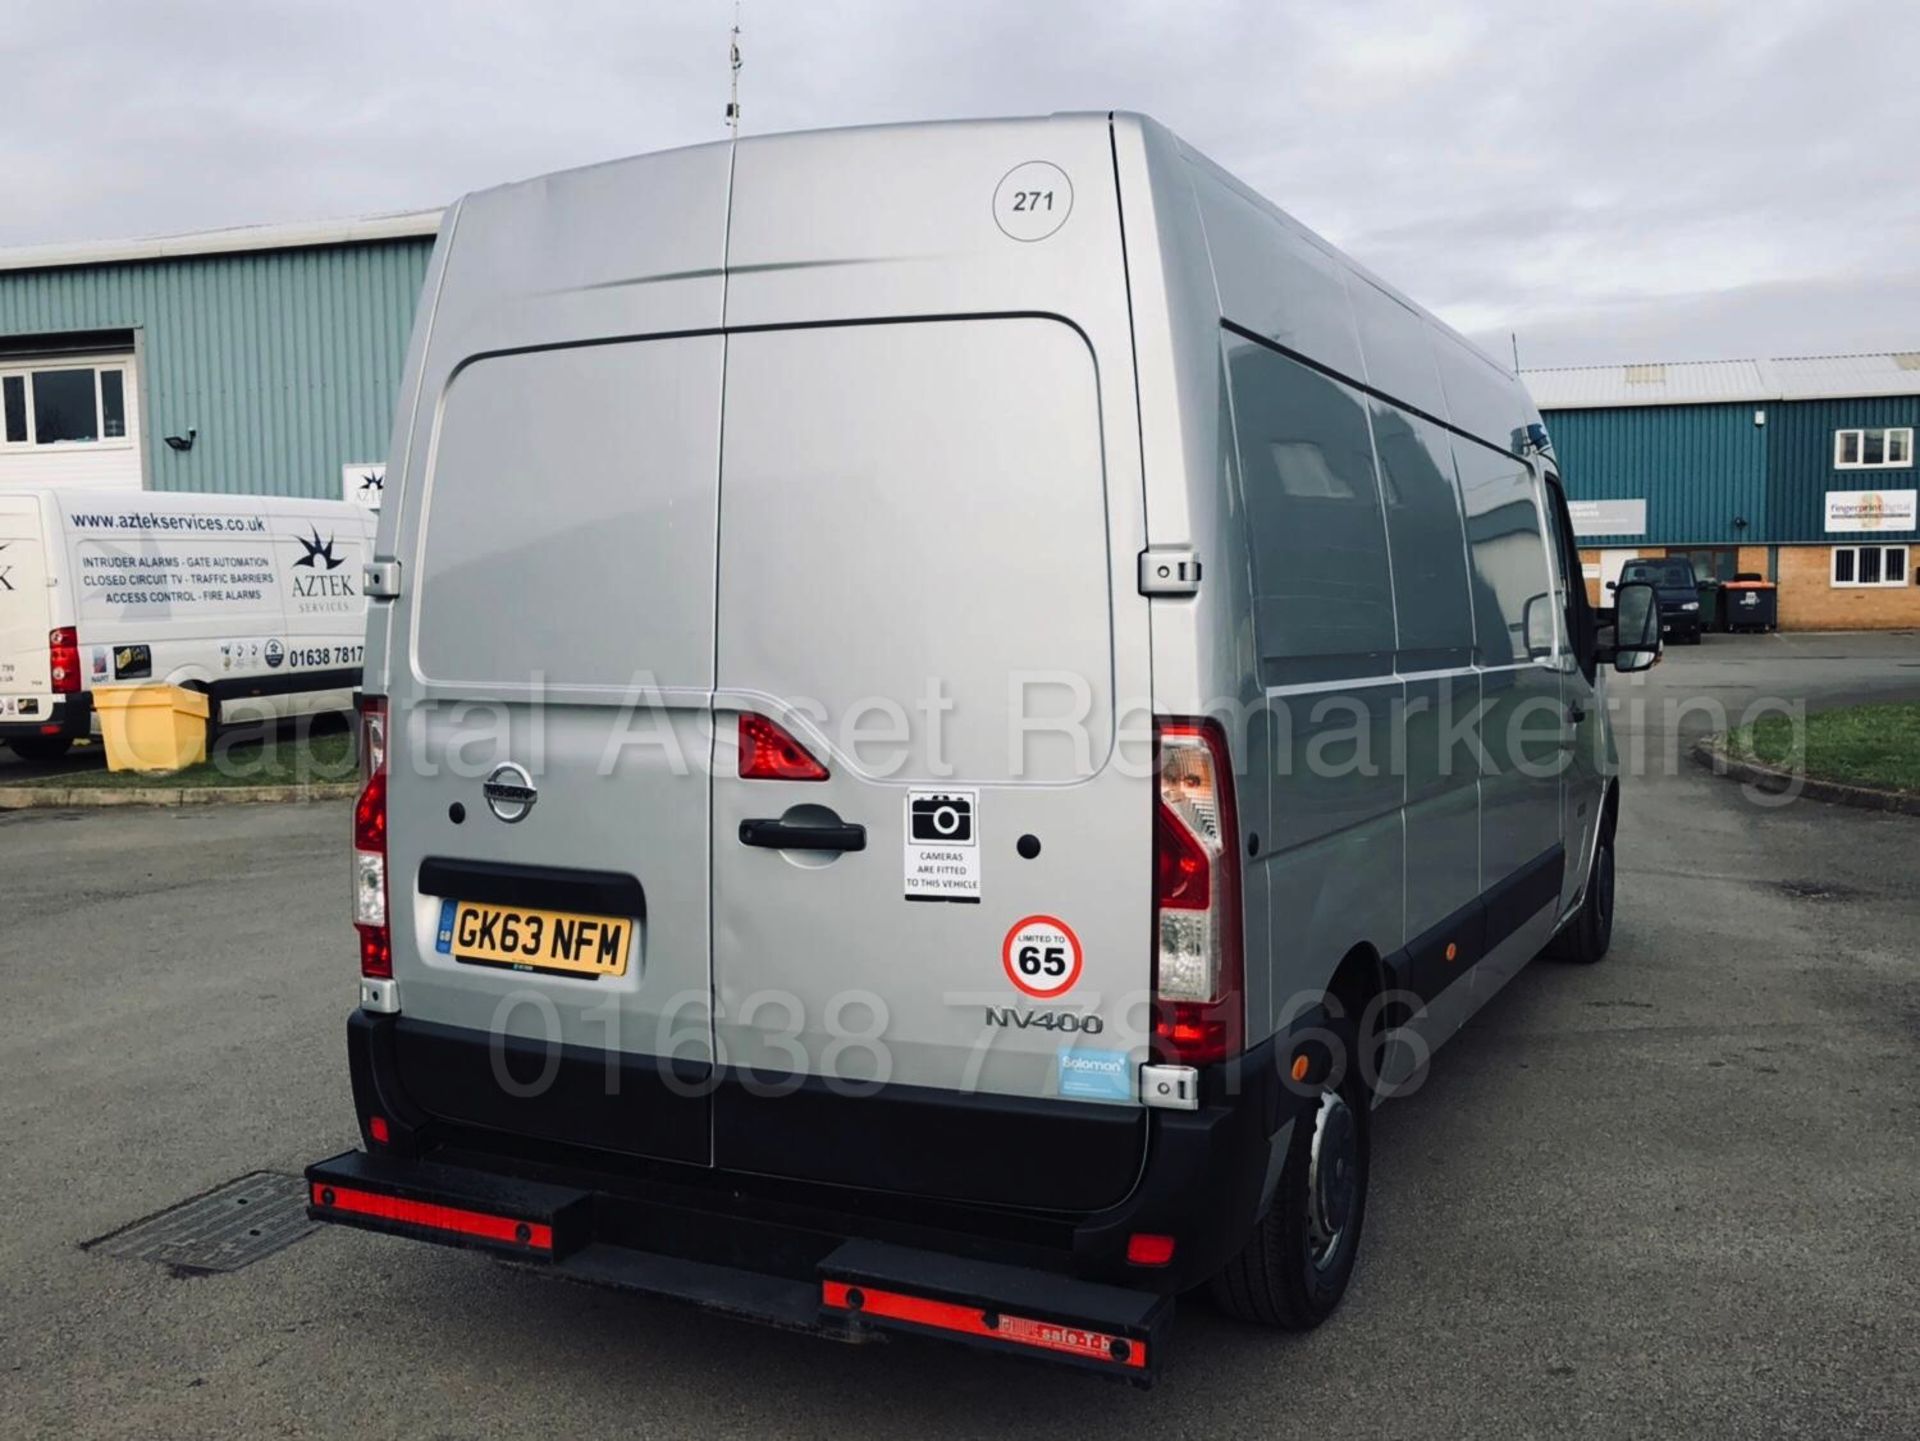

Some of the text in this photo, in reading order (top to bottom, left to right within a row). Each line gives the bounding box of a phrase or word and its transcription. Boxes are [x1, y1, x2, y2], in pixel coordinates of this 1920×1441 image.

[1013, 191, 1054, 211] 271
[71, 512, 266, 532] www.aztekservices.co.uk
[83, 556, 269, 568] INTRUDER ALARMS GATE AUTOMATION
[83, 572, 274, 586] CLOSED CIRCUIT TV TRAFFIC BARRIERS
[292, 574, 355, 598] AZTEK
[105, 589, 262, 604] ACCESS CONTROL FIRE ALARMS
[299, 601, 349, 613] SERVICES
[289, 650, 331, 668] 01638
[334, 646, 364, 664] 7817
[920, 852, 964, 861] CAMERAS
[917, 865, 967, 875] ARE FITTED
[907, 878, 977, 889] TO THIS VEHICLE
[458, 908, 622, 966] GK63 NFM
[1018, 934, 1066, 943] LIMITED TO
[1018, 946, 1066, 976] 65
[985, 1006, 1104, 1034] NV400
